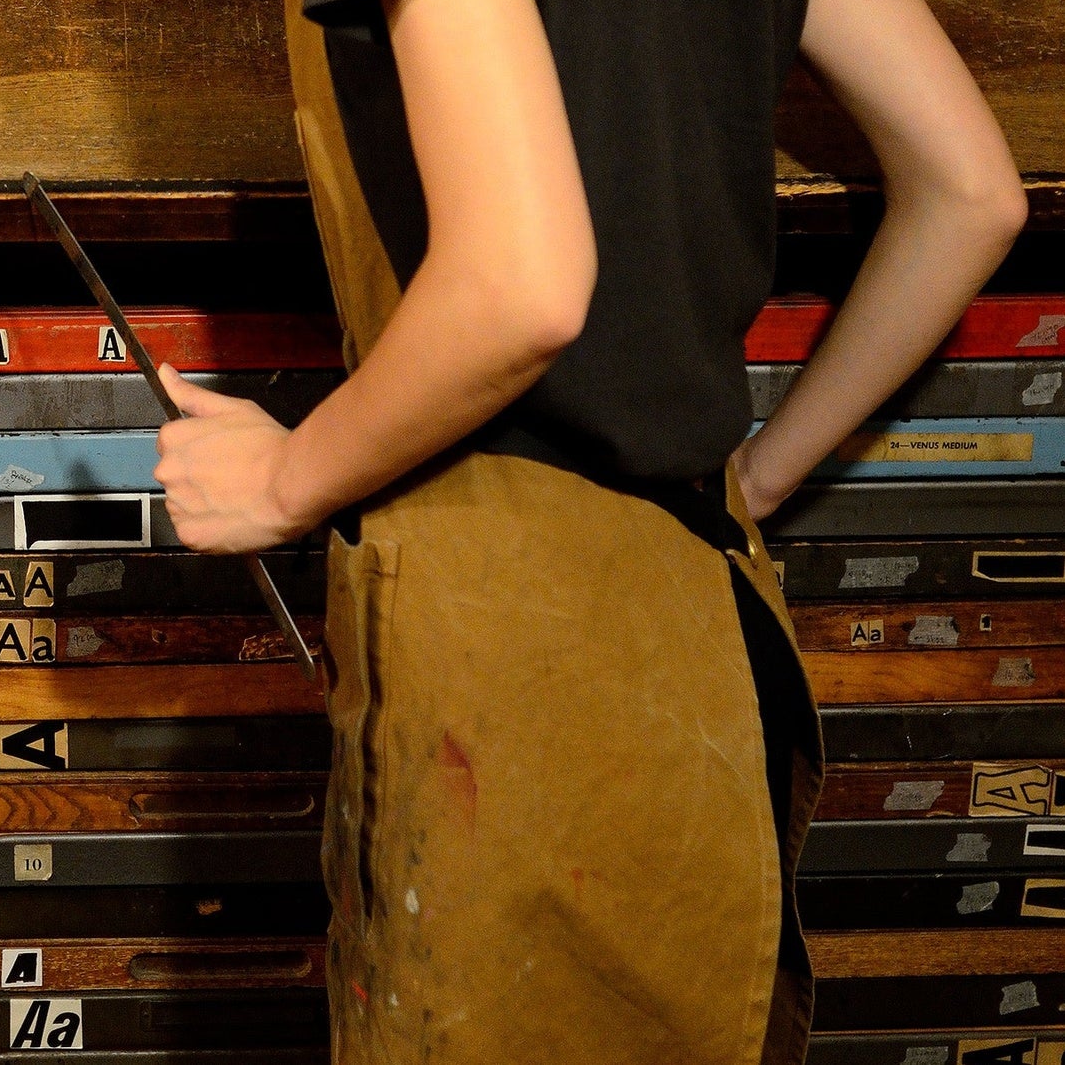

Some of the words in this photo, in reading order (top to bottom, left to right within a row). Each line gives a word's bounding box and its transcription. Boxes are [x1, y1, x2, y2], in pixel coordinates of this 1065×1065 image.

[99, 328, 124, 361] A
[941, 441, 978, 450] MEDIUM
[26, 567, 54, 598] A
[852, 622, 882, 642] Aa
[1, 720, 66, 770] A
[23, 858, 42, 871] 10
[5, 953, 38, 984] A
[11, 1000, 81, 1048] Aa
